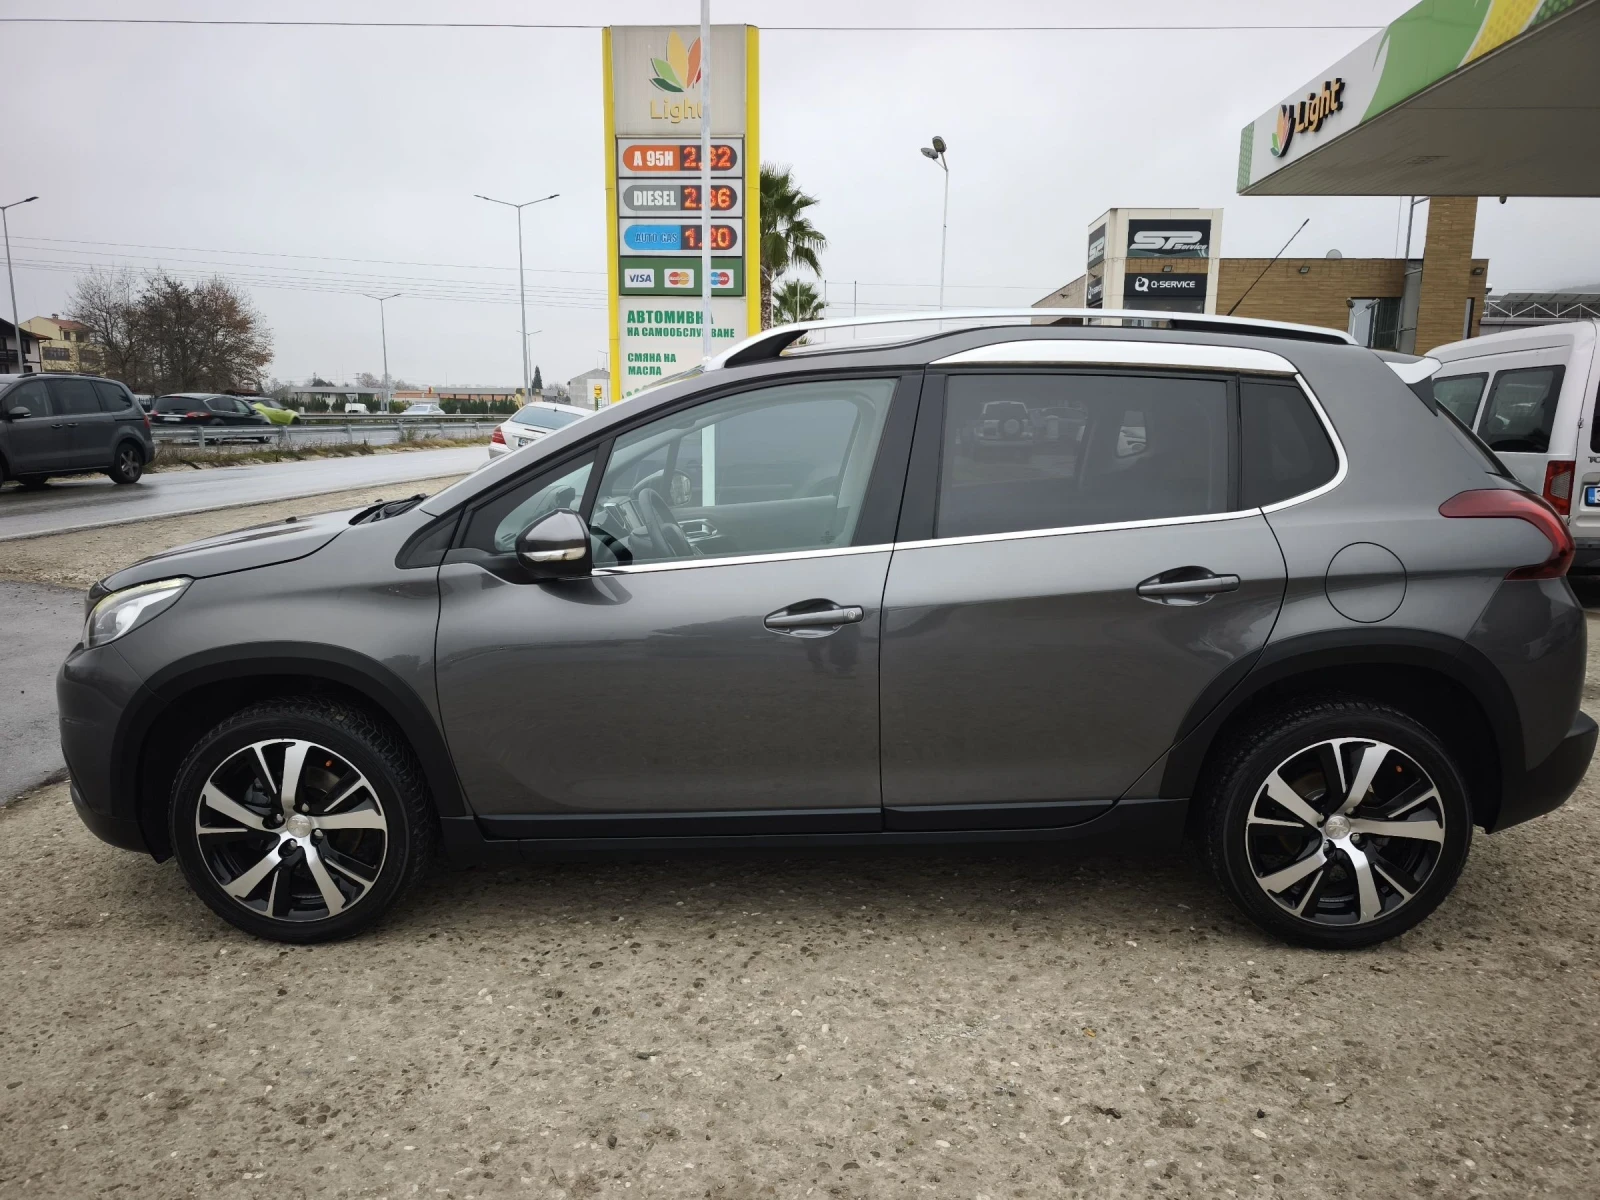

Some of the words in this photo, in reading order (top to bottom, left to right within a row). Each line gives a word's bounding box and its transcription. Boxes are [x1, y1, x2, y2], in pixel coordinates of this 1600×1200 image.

[1295, 78, 1345, 133] Light
[633, 190, 677, 206] DIESEL
[635, 233, 658, 243] AUTO
[661, 233, 678, 243] GAS
[629, 274, 652, 283] VISA
[627, 327, 640, 336] НА
[642, 327, 735, 338] САМООБСЛУВАНЕ
[627, 352, 661, 362] СМЯНА
[664, 353, 676, 362] НА
[628, 365, 662, 375] МАСЛА
